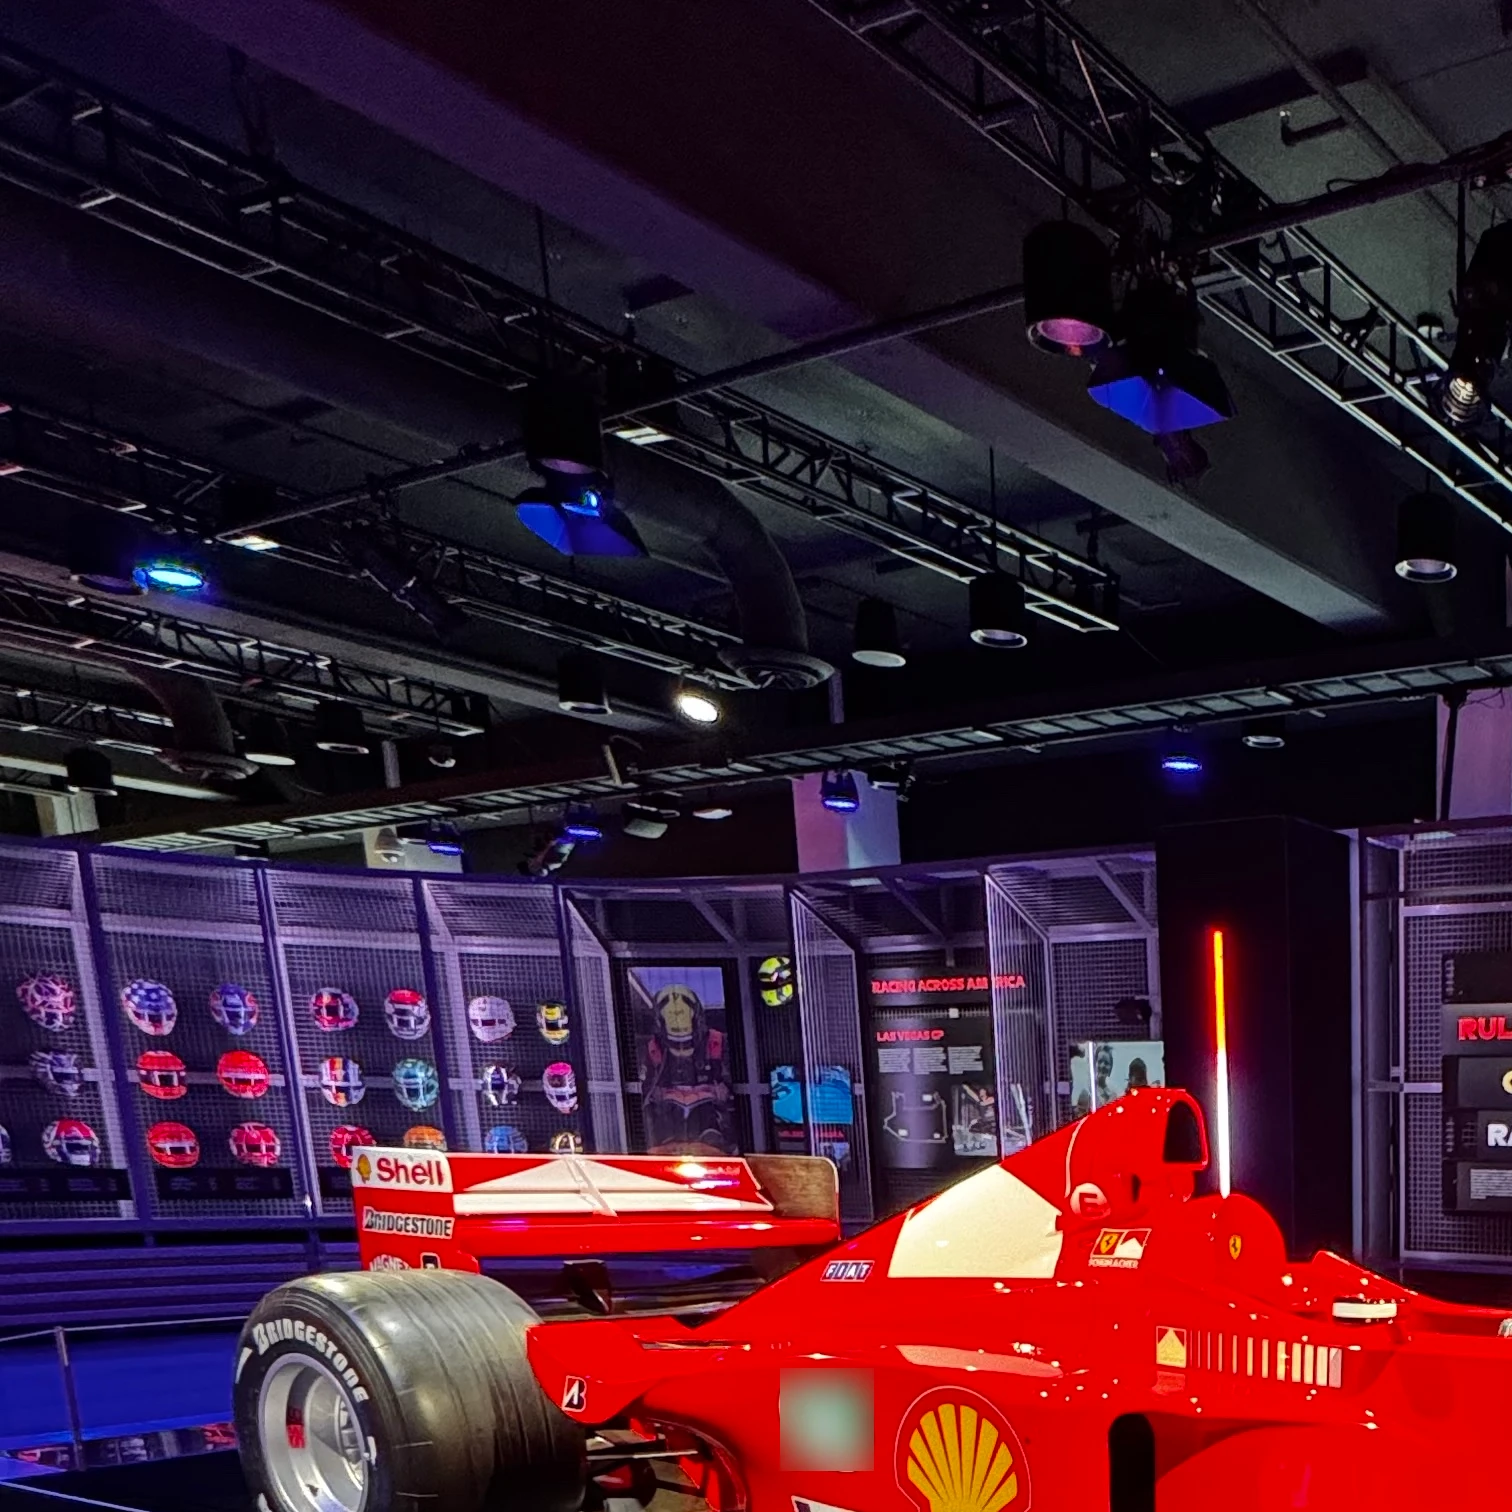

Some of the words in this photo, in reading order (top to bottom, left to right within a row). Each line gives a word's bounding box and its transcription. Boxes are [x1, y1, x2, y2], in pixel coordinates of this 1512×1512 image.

[917, 978, 965, 992] ACROSS
[966, 975, 1026, 990] AMRICA
[376, 1157, 444, 1186] Shell
[364, 1208, 452, 1237] BRIDGESTONE
[825, 1264, 870, 1278] FIAT
[252, 1318, 369, 1403] BRIDGESTONE
